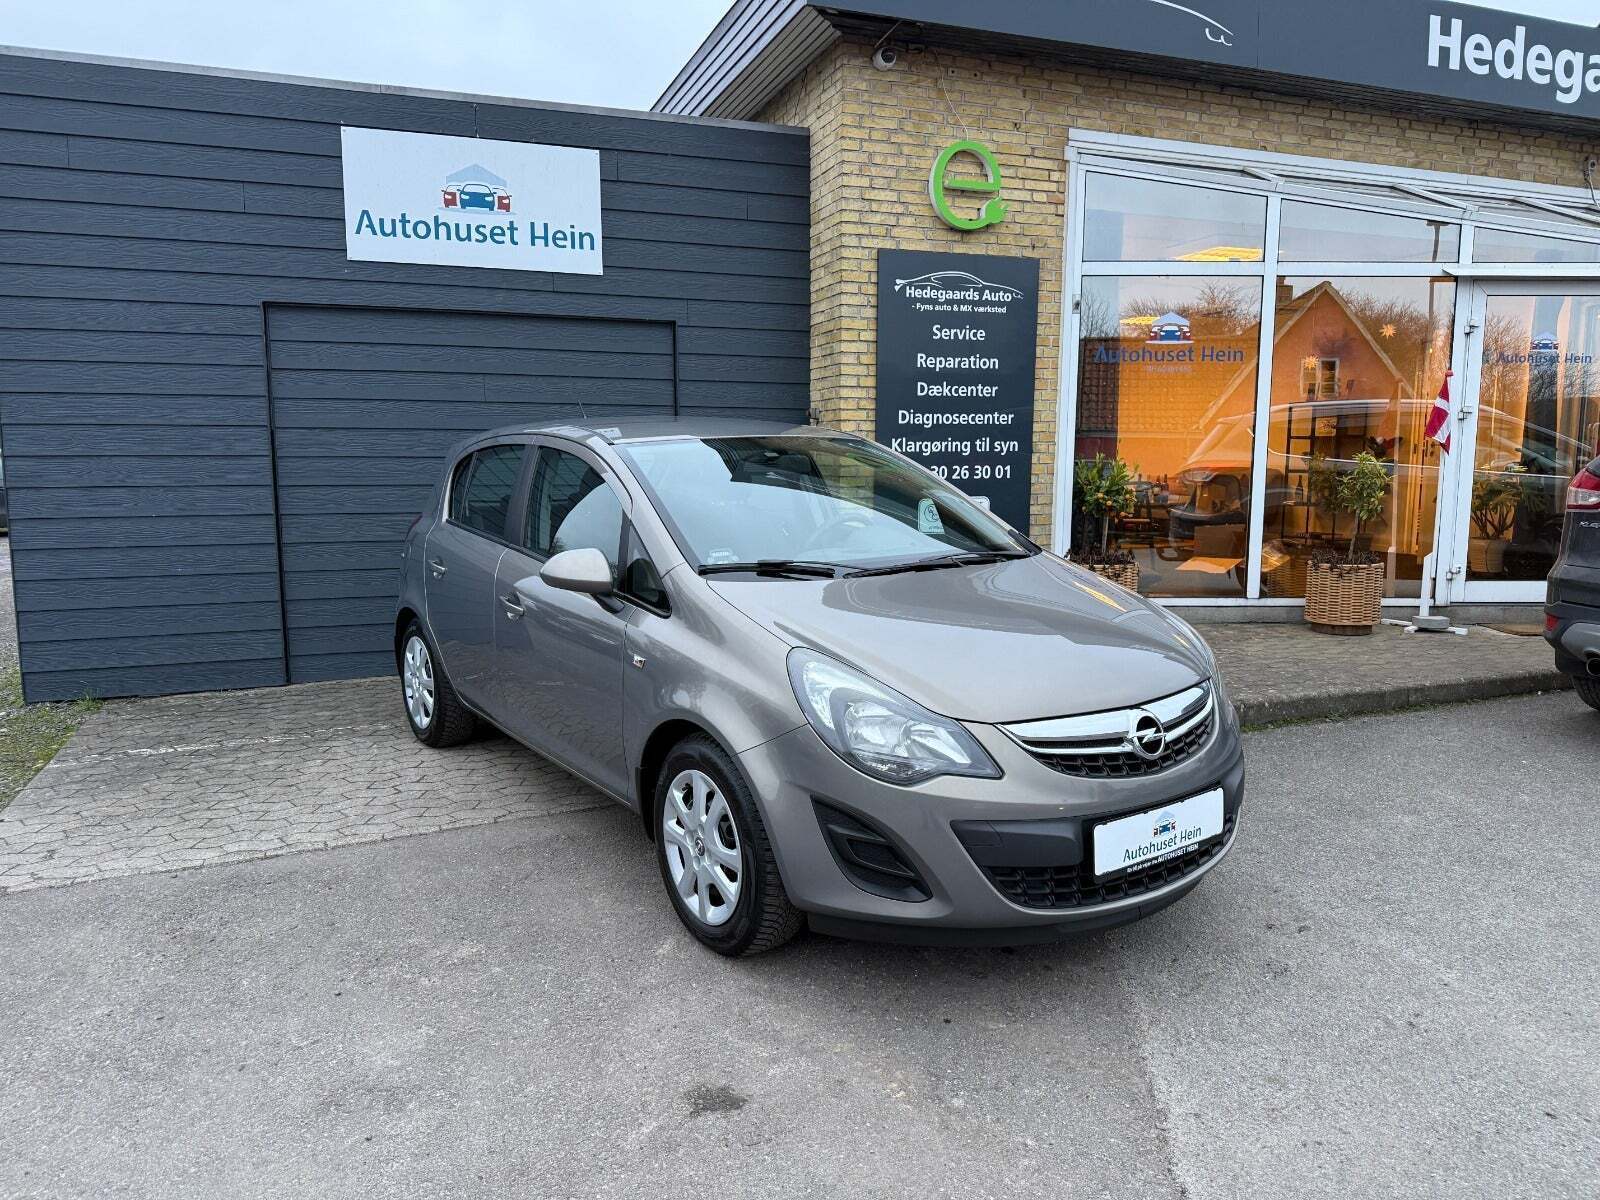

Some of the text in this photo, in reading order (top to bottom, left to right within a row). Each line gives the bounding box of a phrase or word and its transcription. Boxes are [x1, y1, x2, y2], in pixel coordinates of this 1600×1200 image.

[354, 209, 595, 250] Autohuset Hein
[905, 286, 1012, 302] Hedegaards Auto
[916, 303, 934, 312] Fyns
[973, 305, 1007, 313] værksted
[932, 324, 986, 341] Service
[916, 353, 999, 371] Reparation
[1094, 345, 1244, 363] Autohuset Hein
[1497, 352, 1592, 364] Autohuset Hein
[916, 381, 999, 397] Dækcenter
[898, 409, 1015, 428] Diagnosecenter
[891, 437, 1019, 456] Klargøring til syn
[951, 465, 970, 480] 26
[973, 465, 991, 479] 30
[994, 465, 1011, 479] 01
[1122, 826, 1202, 862] Autohuset Hein
[1158, 847, 1187, 863] AUTOHUSET
